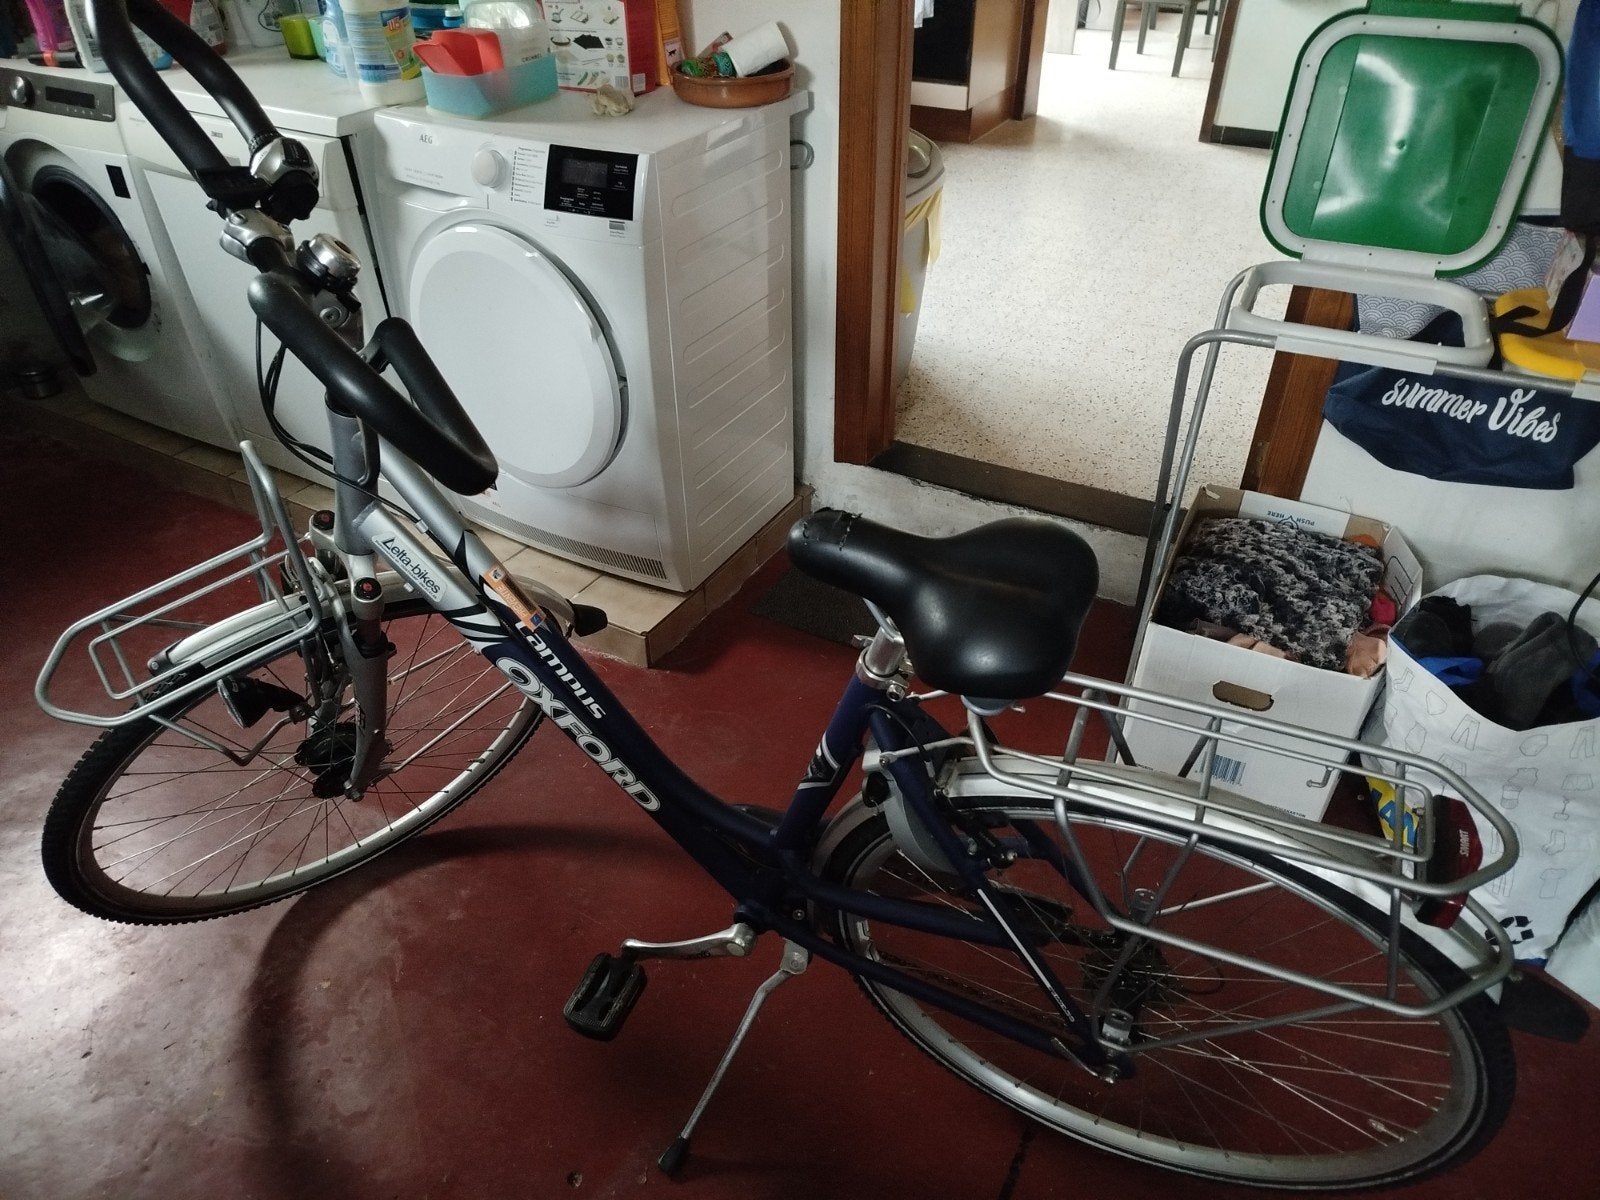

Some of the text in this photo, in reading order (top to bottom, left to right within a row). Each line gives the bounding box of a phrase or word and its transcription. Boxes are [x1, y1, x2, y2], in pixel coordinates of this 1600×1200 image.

[419, 133, 433, 145] AEG
[1381, 377, 1561, 443] summer Vibes
[1266, 510, 1315, 527] PUSH HERE
[496, 657, 661, 813] OXFORD
[1458, 829, 1470, 857] SMART
